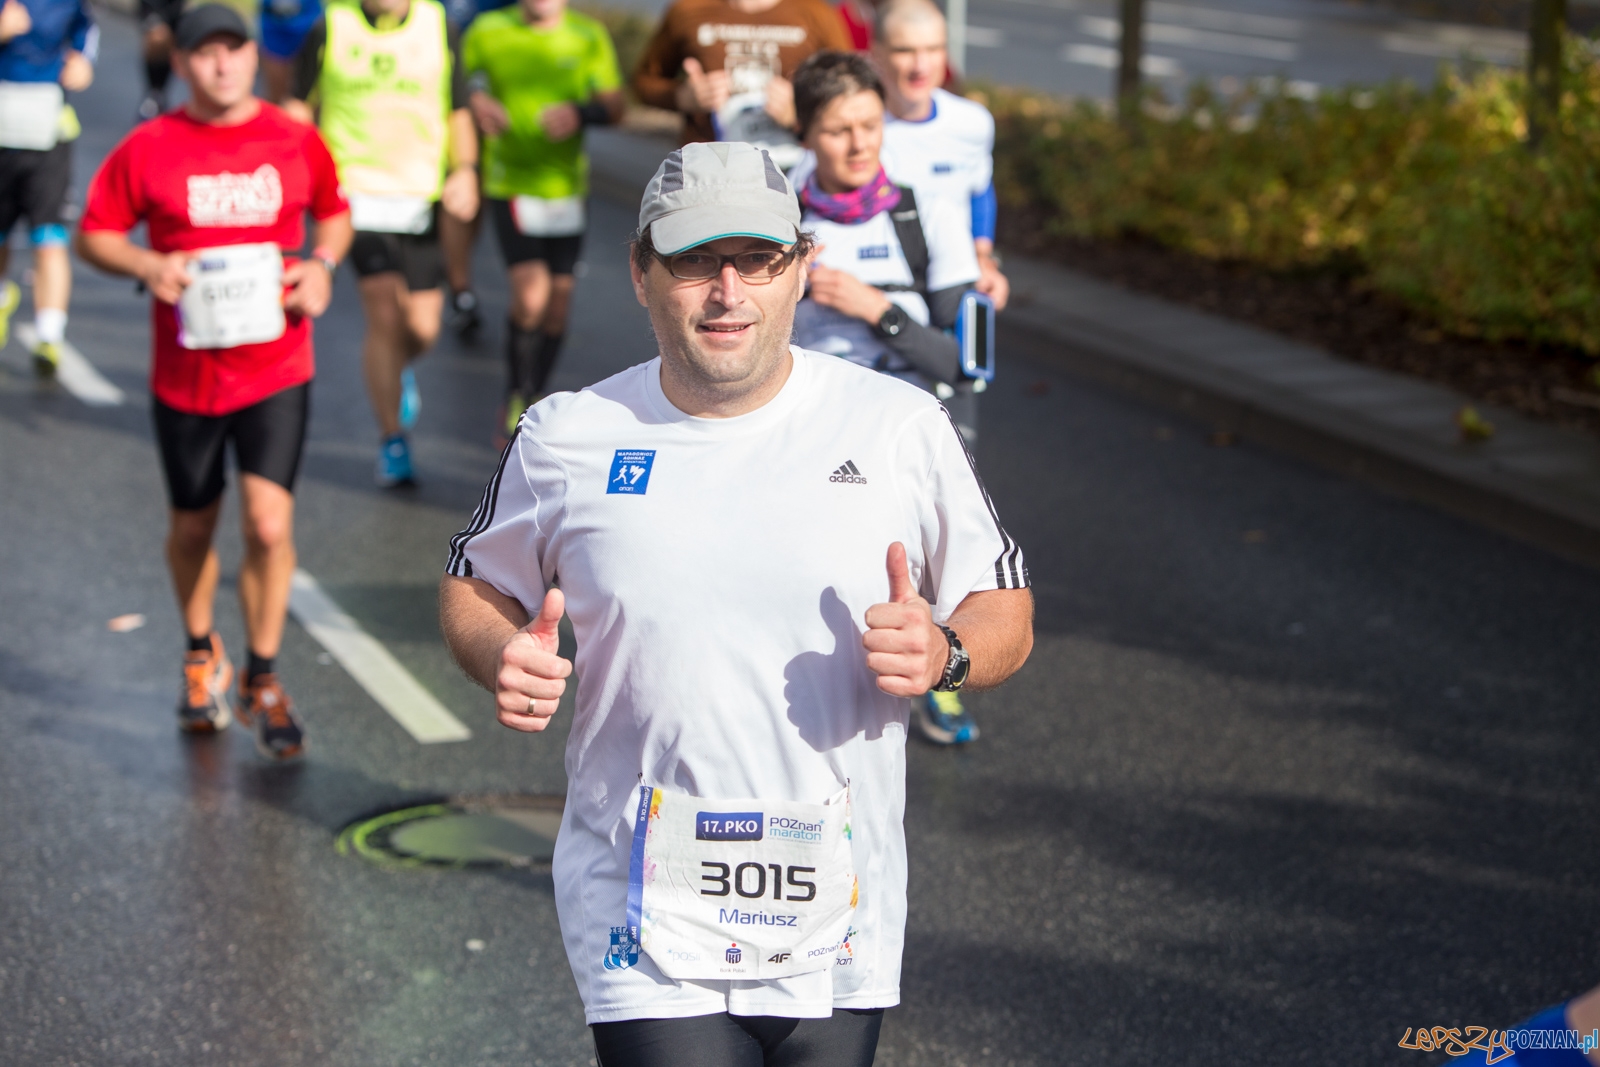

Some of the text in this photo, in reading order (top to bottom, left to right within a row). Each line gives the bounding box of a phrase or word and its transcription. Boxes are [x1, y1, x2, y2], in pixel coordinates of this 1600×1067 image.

[829, 474, 867, 484] adidas
[702, 820, 758, 833] 17. PKO
[769, 828, 822, 841] maraton
[700, 861, 817, 902] 3015
[719, 908, 798, 927] Mariusz
